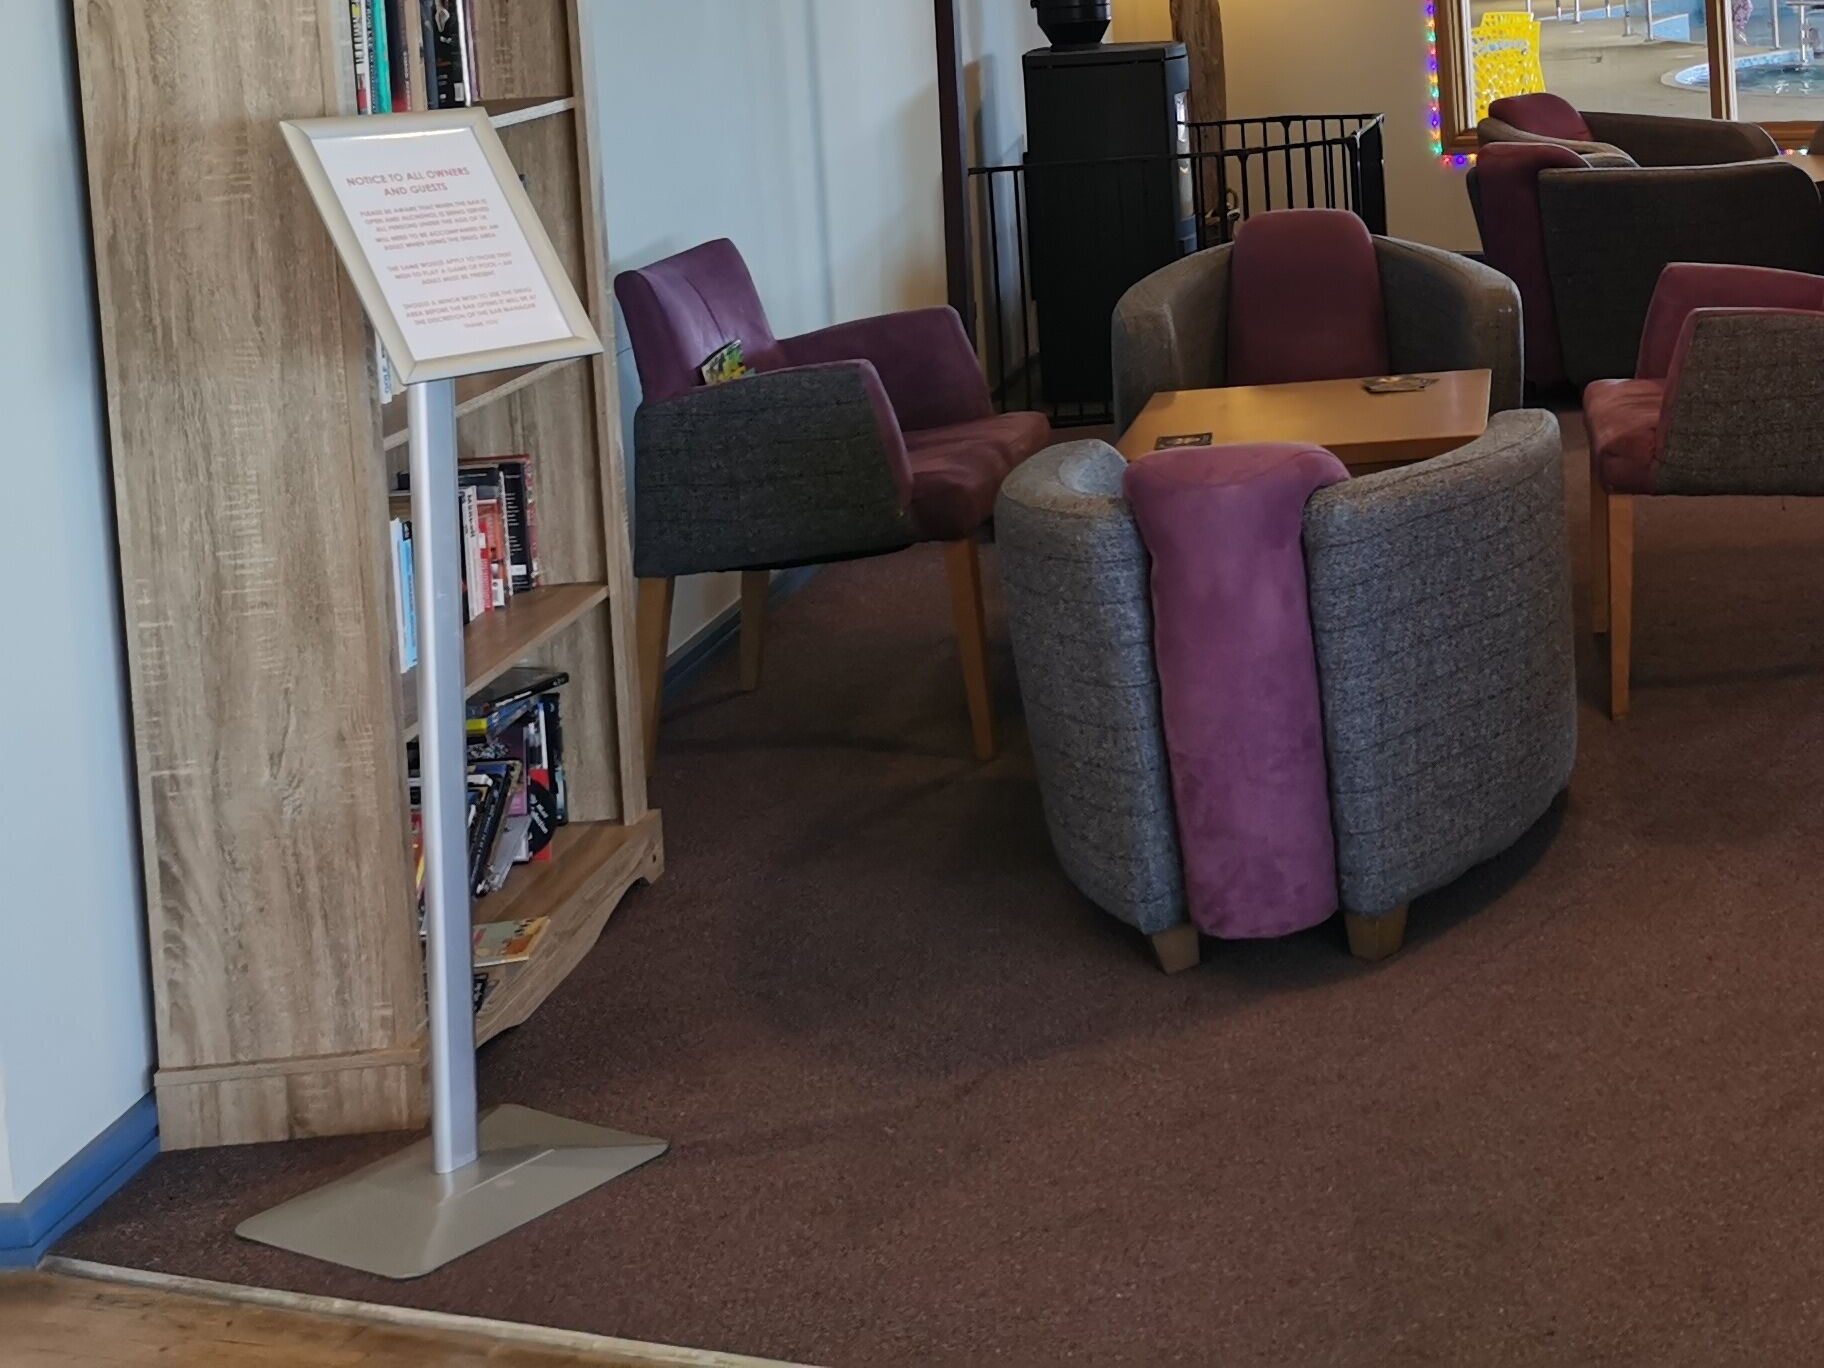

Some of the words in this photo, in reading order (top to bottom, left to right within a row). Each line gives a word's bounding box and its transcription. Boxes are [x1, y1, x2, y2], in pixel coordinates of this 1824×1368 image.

[346, 174, 387, 186] NOTICE
[388, 172, 403, 182] TO
[407, 170, 425, 181] ALL
[425, 167, 470, 179] OWNERS
[384, 186, 407, 197] AND
[410, 183, 448, 194] GUESTS
